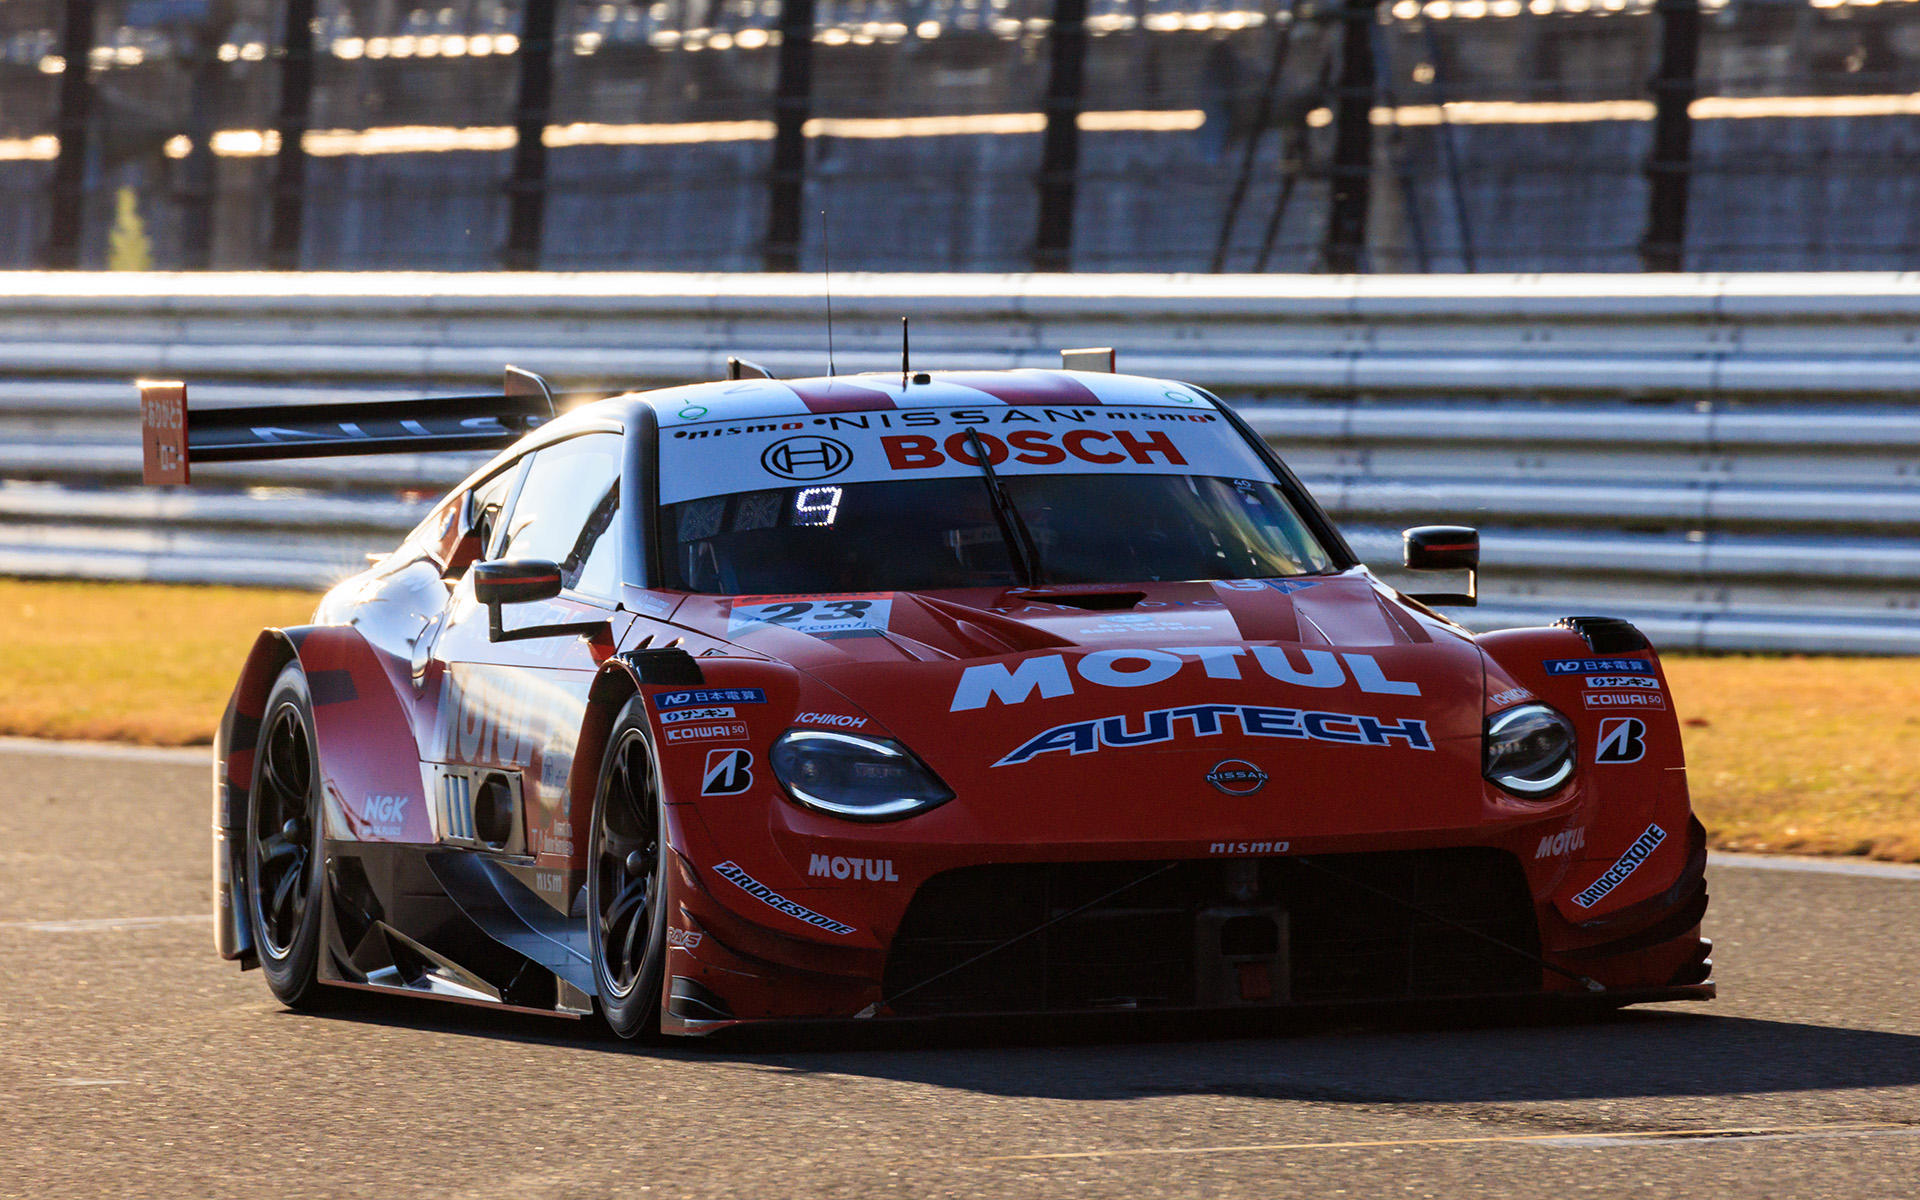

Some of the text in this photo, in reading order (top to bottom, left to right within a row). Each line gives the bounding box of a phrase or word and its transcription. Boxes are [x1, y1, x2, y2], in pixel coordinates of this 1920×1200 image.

[829, 405, 1087, 431] NISSAN
[1106, 410, 1208, 423] nismo
[688, 421, 804, 440] nismo
[880, 430, 1189, 470] BOSCH
[760, 601, 873, 624] 23
[949, 645, 1422, 713] MOTUL
[1606, 677, 1653, 687] サンキン
[1489, 687, 1534, 706] ICHIKOH
[1649, 696, 1662, 705] 50
[680, 708, 730, 720] サンキン
[795, 712, 868, 729] ICHIKOH
[731, 725, 745, 734] 50
[990, 704, 1435, 768] AUTECH
[1206, 771, 1268, 781] NISSAN
[364, 795, 409, 823] NGK
[1209, 841, 1290, 854] nismo
[1535, 826, 1586, 859] MOTUL
[808, 853, 899, 882] MOTUL
[1573, 824, 1666, 908] BRIDGESTONE
[714, 861, 855, 935] BRIDGESTONE
